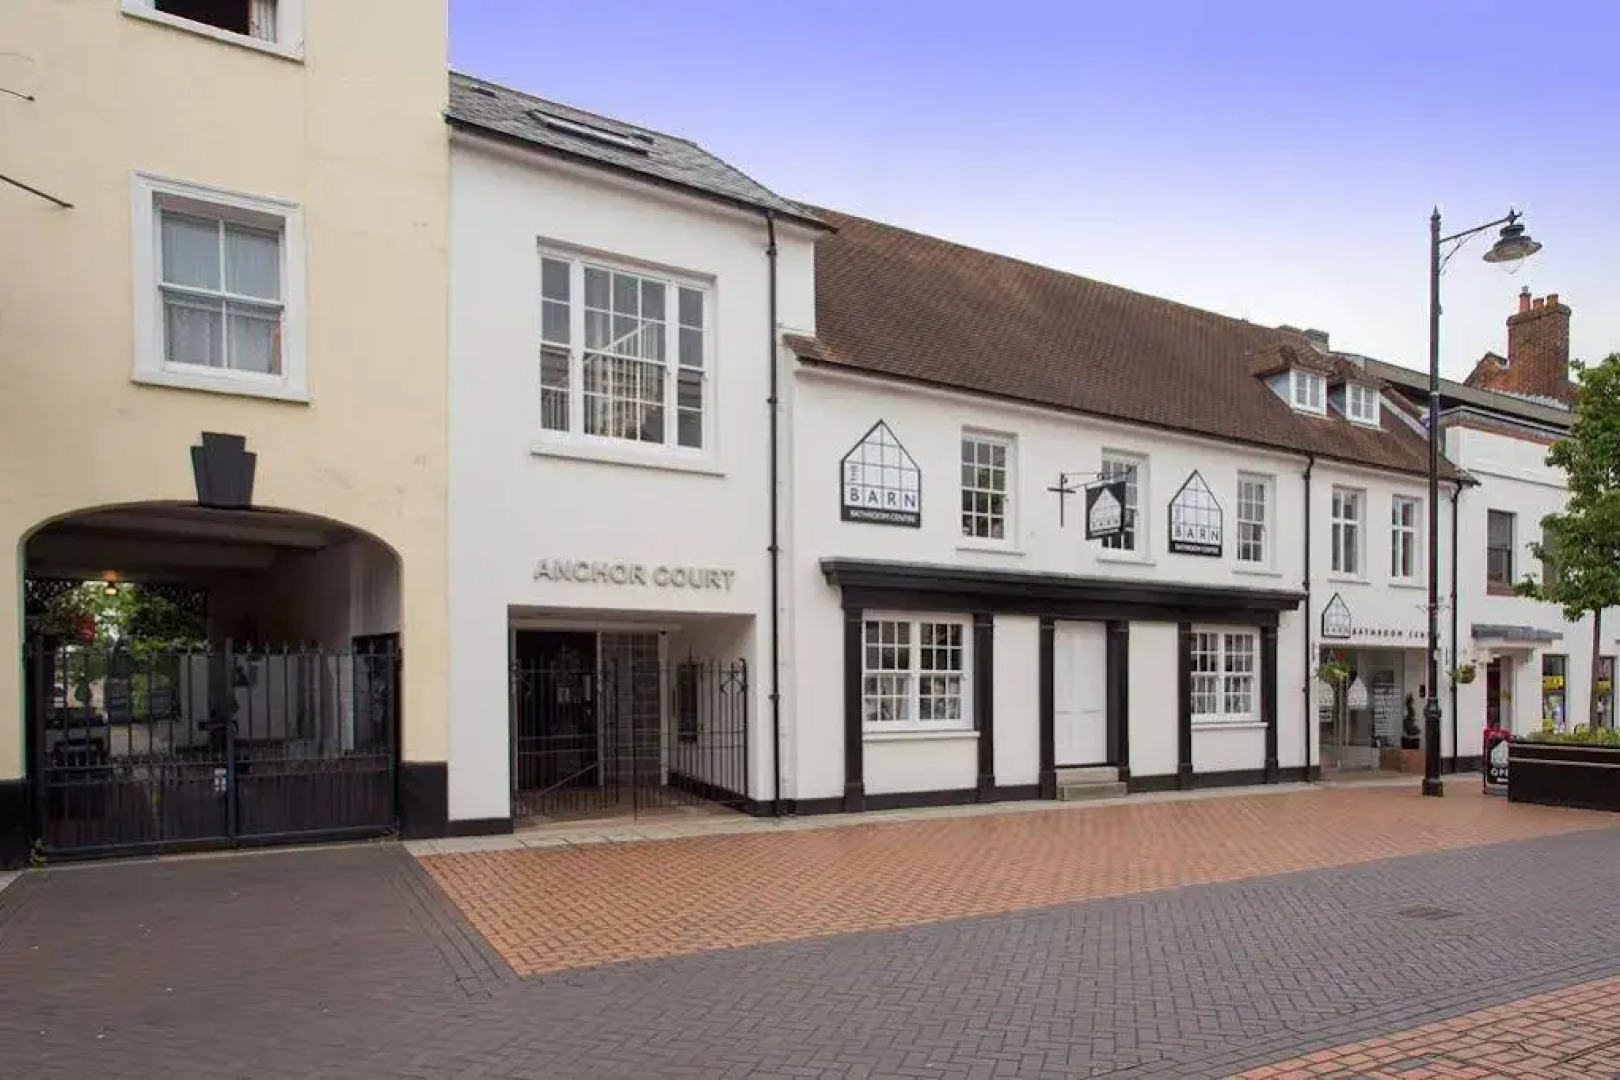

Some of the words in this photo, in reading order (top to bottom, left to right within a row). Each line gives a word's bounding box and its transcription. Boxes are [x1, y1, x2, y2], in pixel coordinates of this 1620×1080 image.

[849, 487, 916, 508] BARN
[1174, 525, 1219, 541] BARN
[533, 558, 647, 586] ANCHOR
[652, 565, 736, 592] COURT
